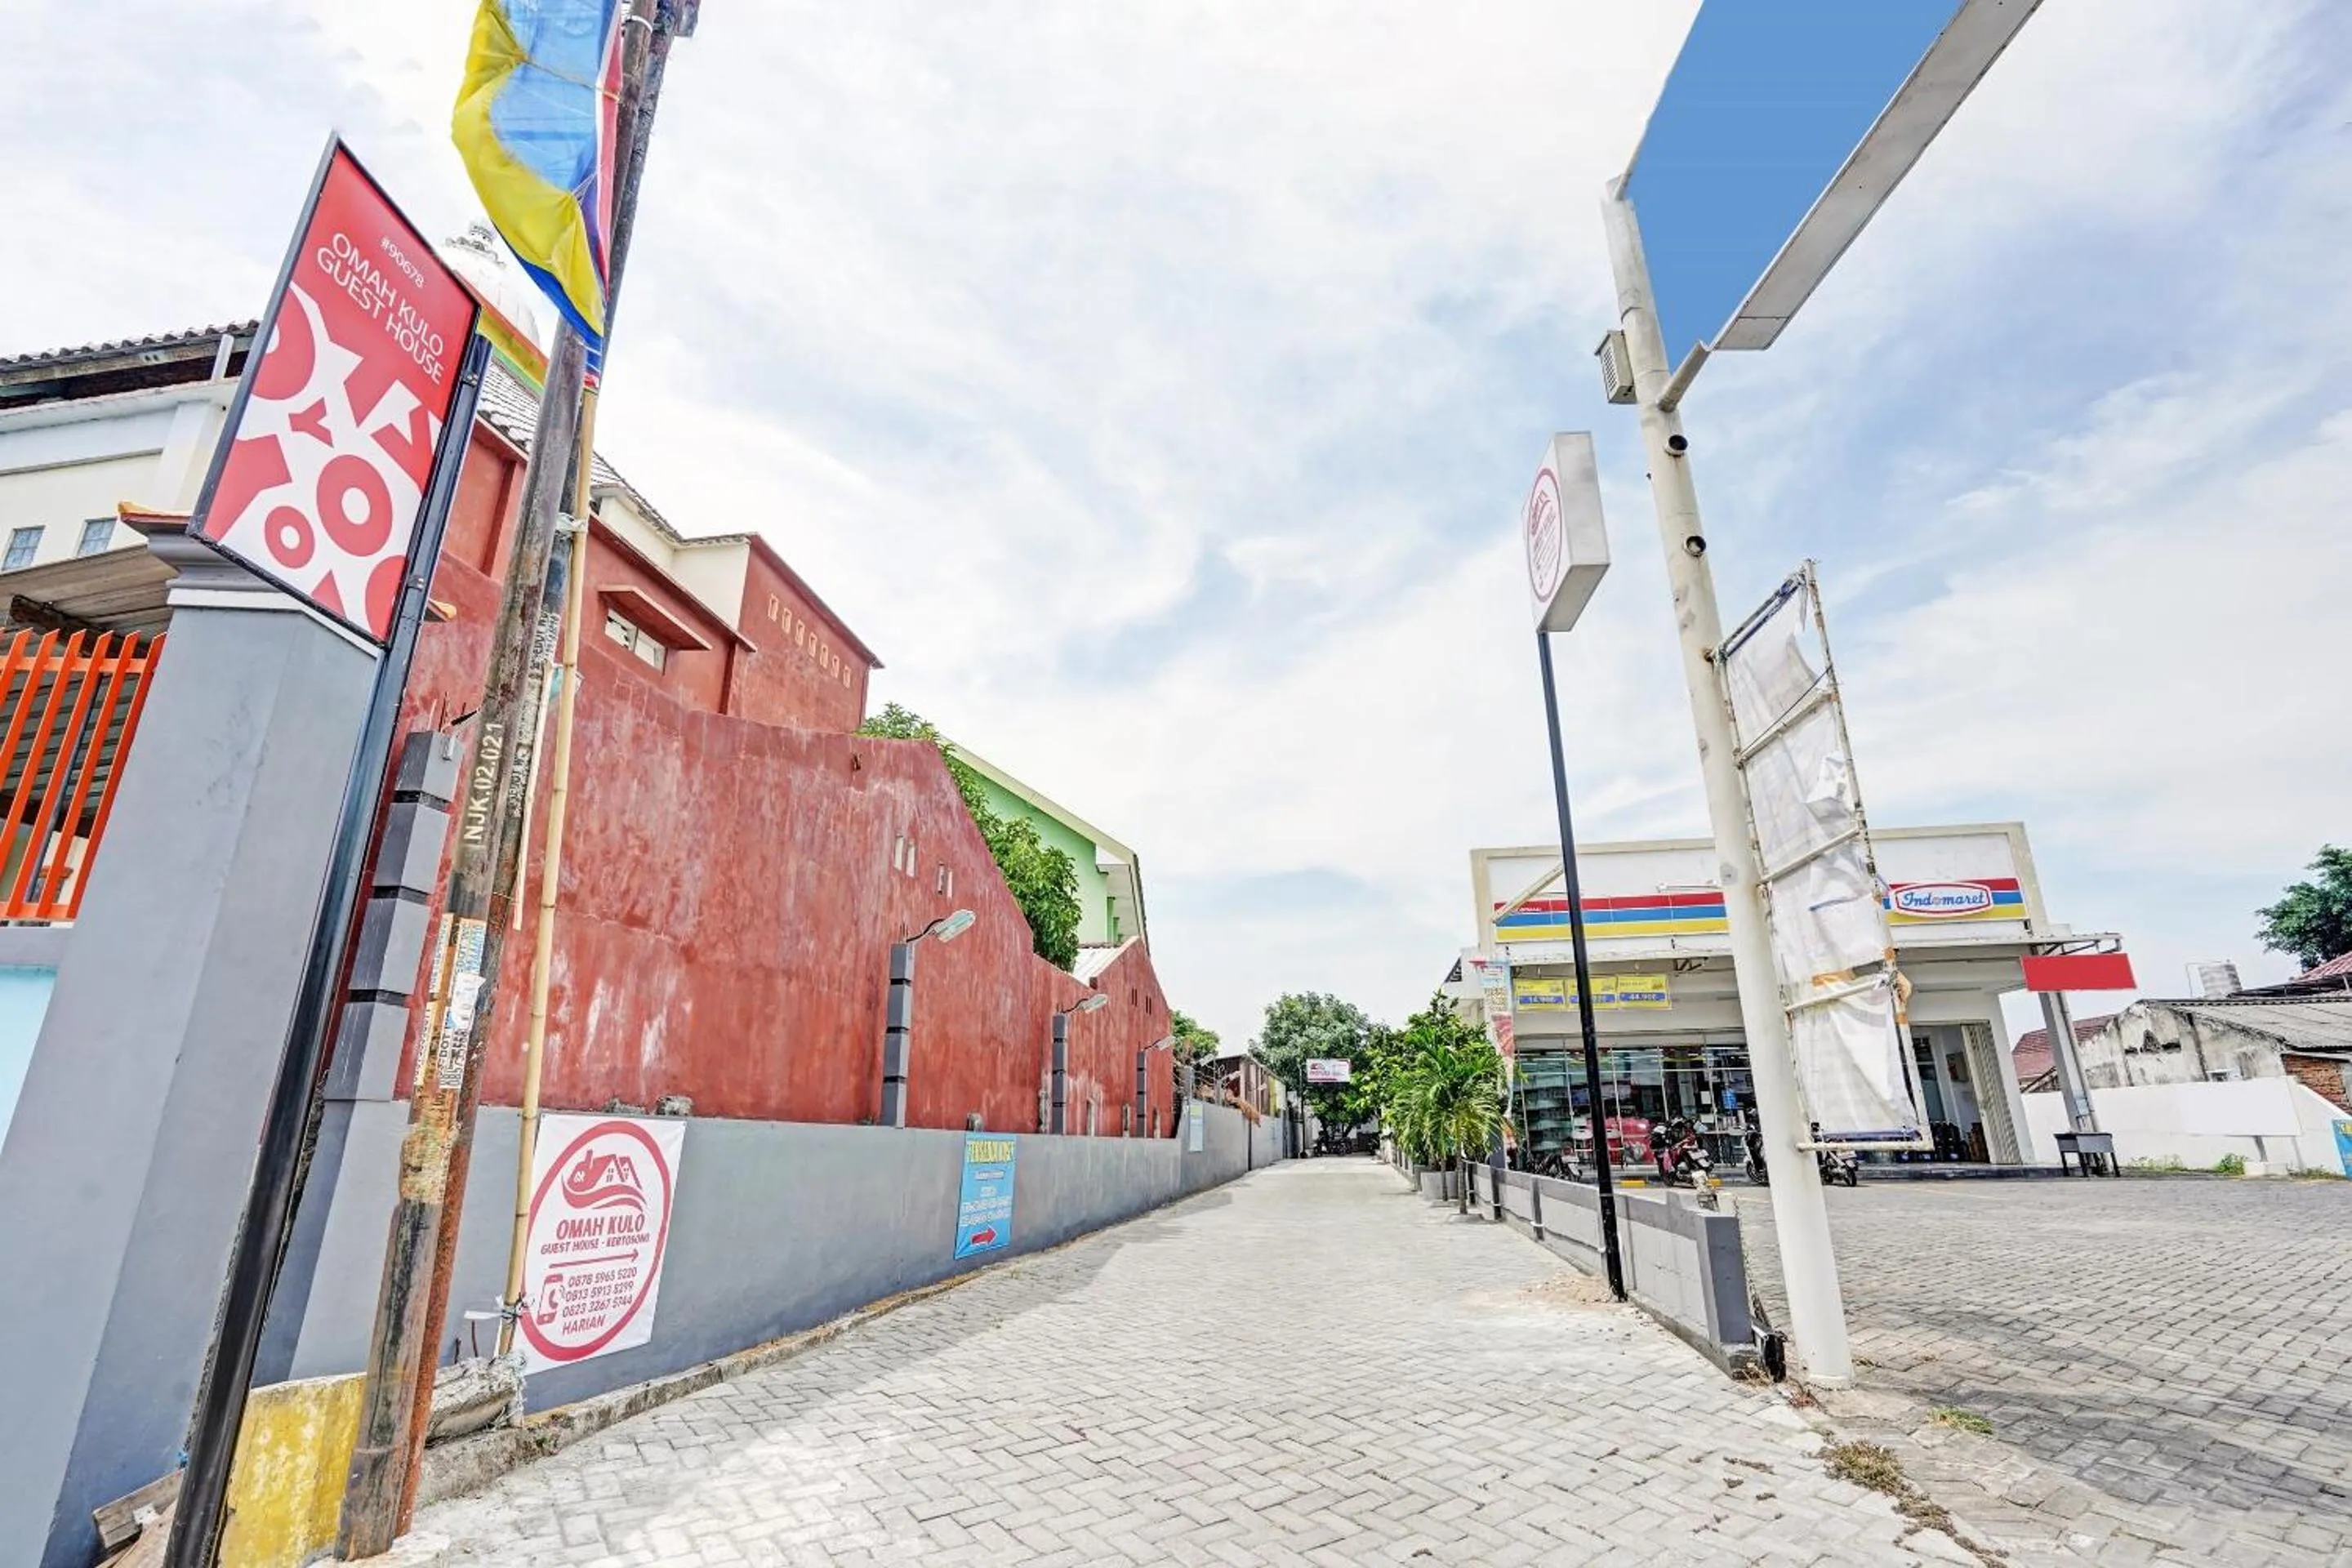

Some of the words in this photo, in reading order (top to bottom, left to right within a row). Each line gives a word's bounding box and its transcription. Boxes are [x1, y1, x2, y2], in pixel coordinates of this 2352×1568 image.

[381, 236, 425, 289] #90678
[332, 233, 397, 308] OMAH
[399, 297, 443, 357] KULO
[317, 247, 385, 319] GUEST
[385, 313, 444, 385] HOUSE
[463, 722, 504, 840] NJK.02.021
[1901, 891, 1985, 906] Indomaret
[541, 1241, 571, 1254] GUEST
[572, 1238, 600, 1252] HOUSE
[556, 1216, 604, 1241] OMAH
[607, 1213, 645, 1235] KULO
[562, 1315, 606, 1336] HARIAN
